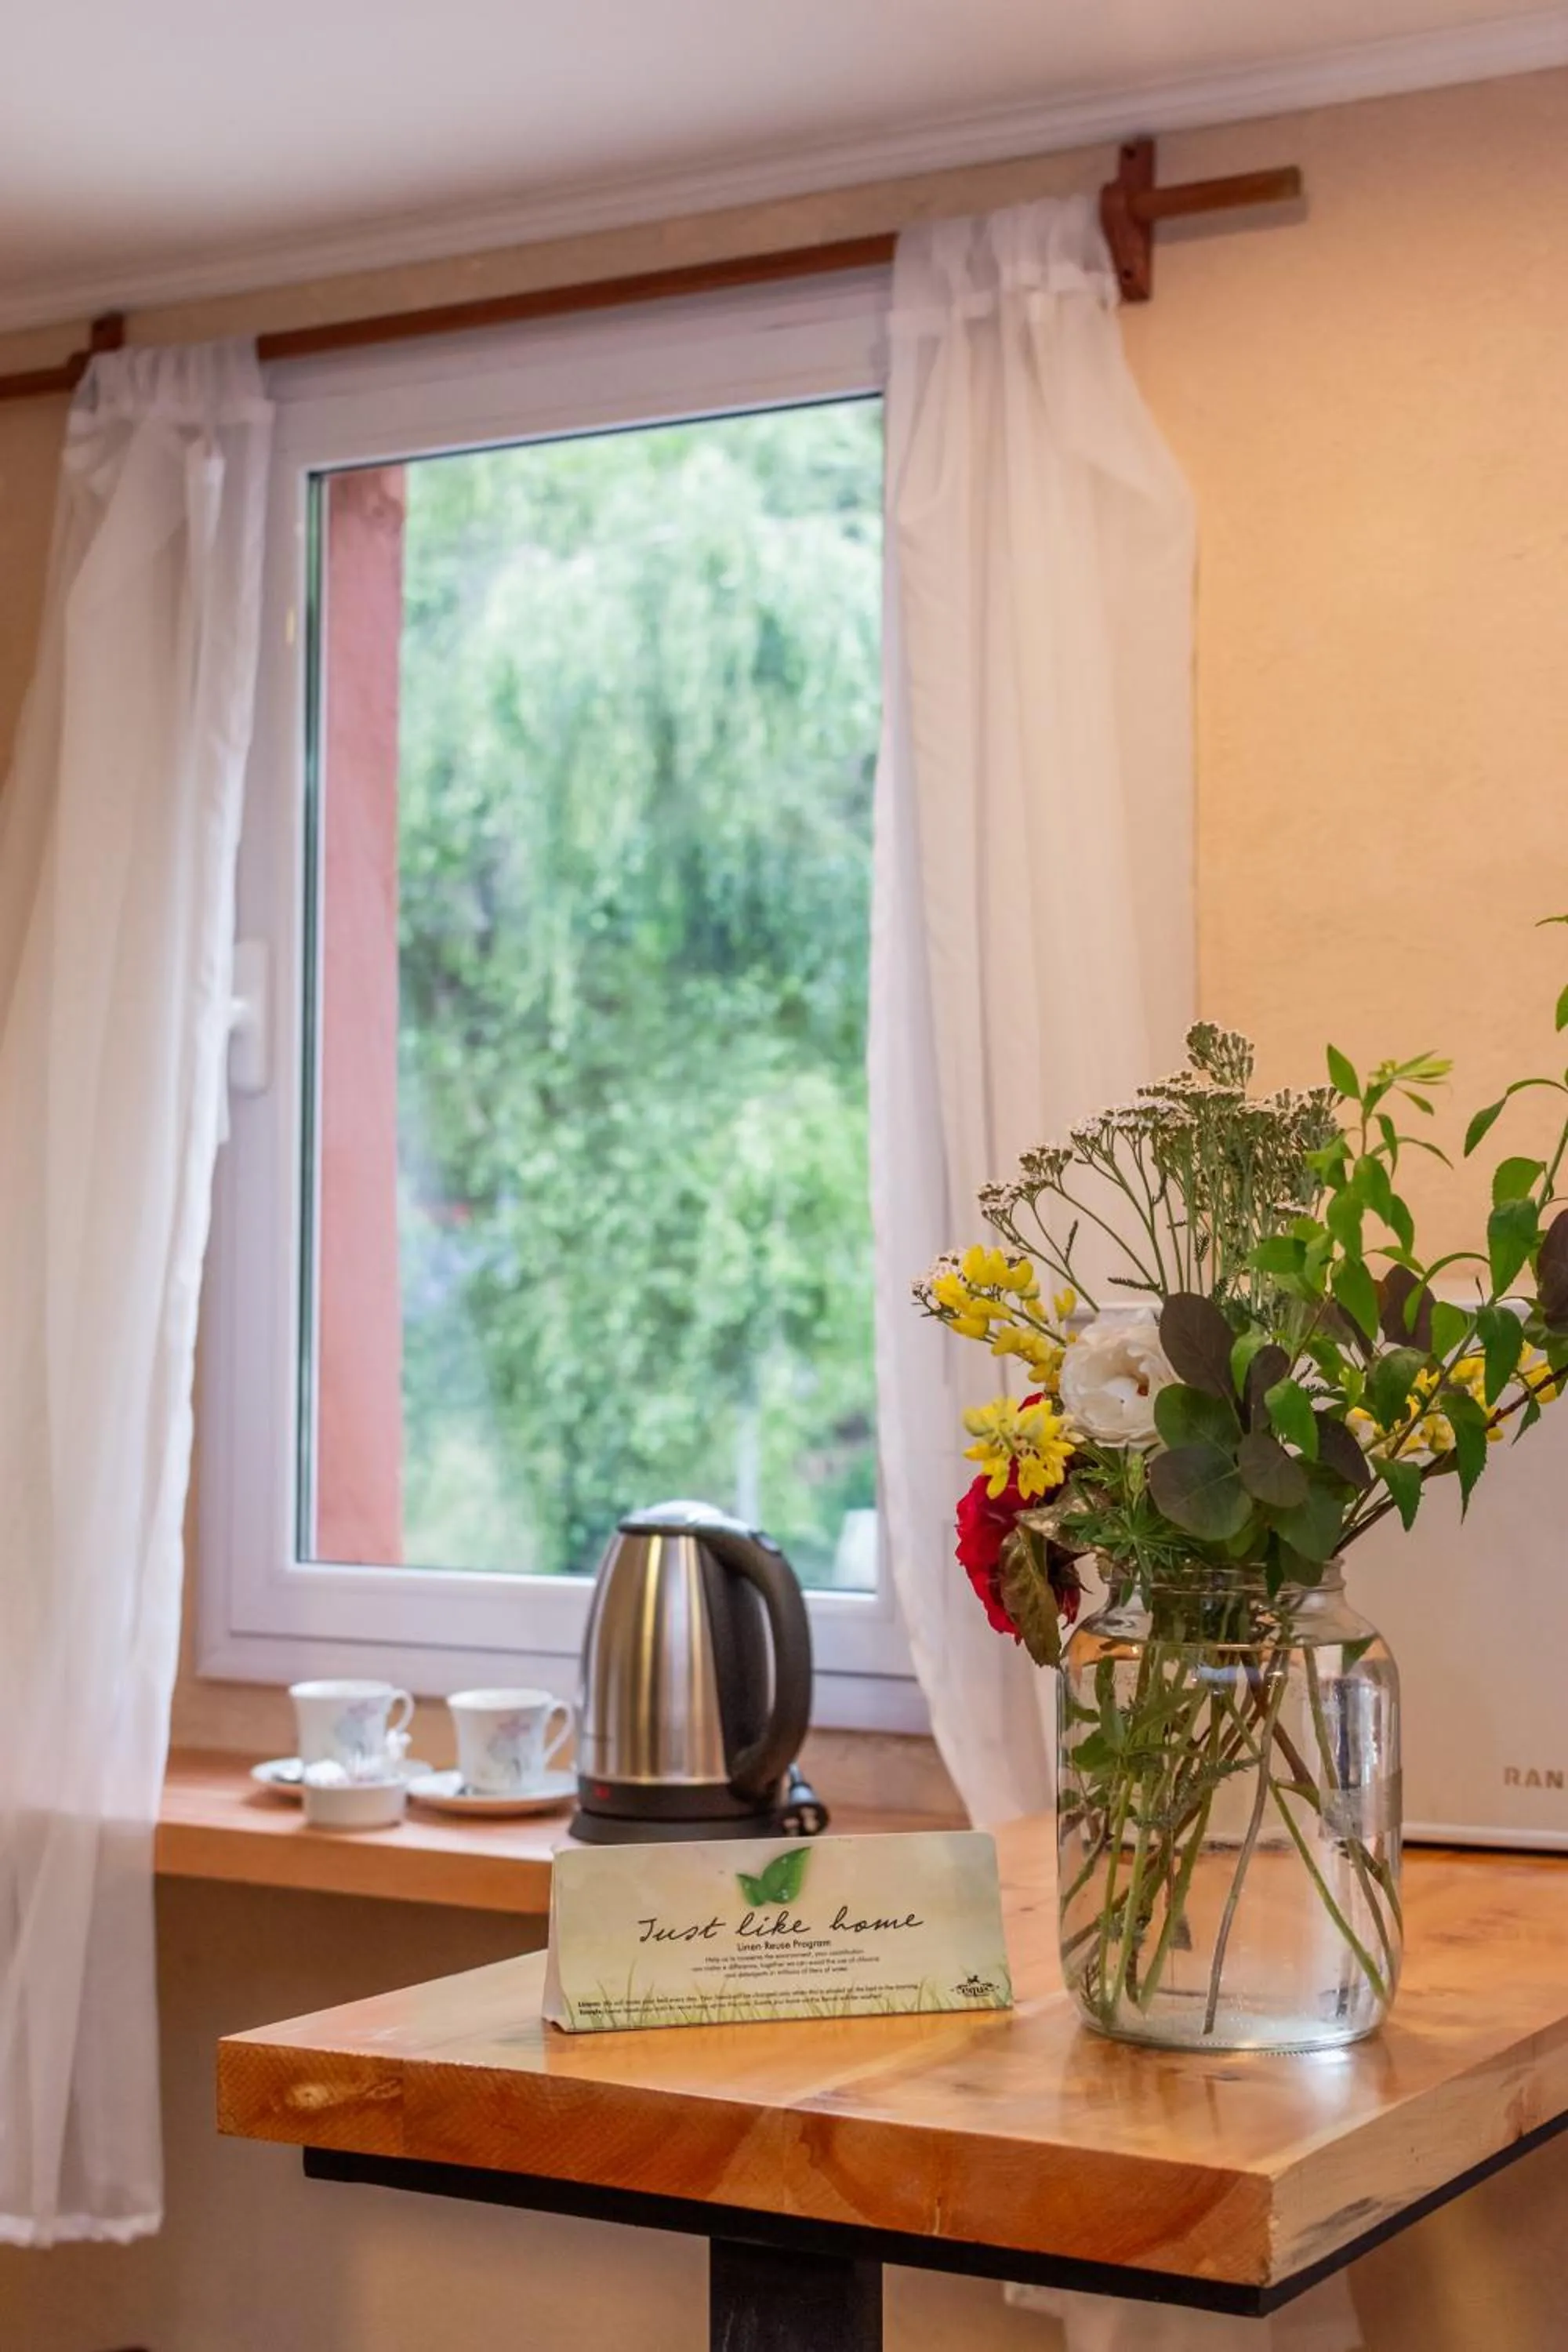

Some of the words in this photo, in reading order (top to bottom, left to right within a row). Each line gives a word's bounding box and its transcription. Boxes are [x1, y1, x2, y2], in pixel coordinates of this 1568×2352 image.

[1504, 1766, 1563, 1789] RAN
[638, 1918, 726, 1942] Just
[735, 1911, 811, 1936] like
[829, 1906, 924, 1931] home
[737, 1943, 761, 1951] Linen
[793, 1939, 831, 1949] Program
